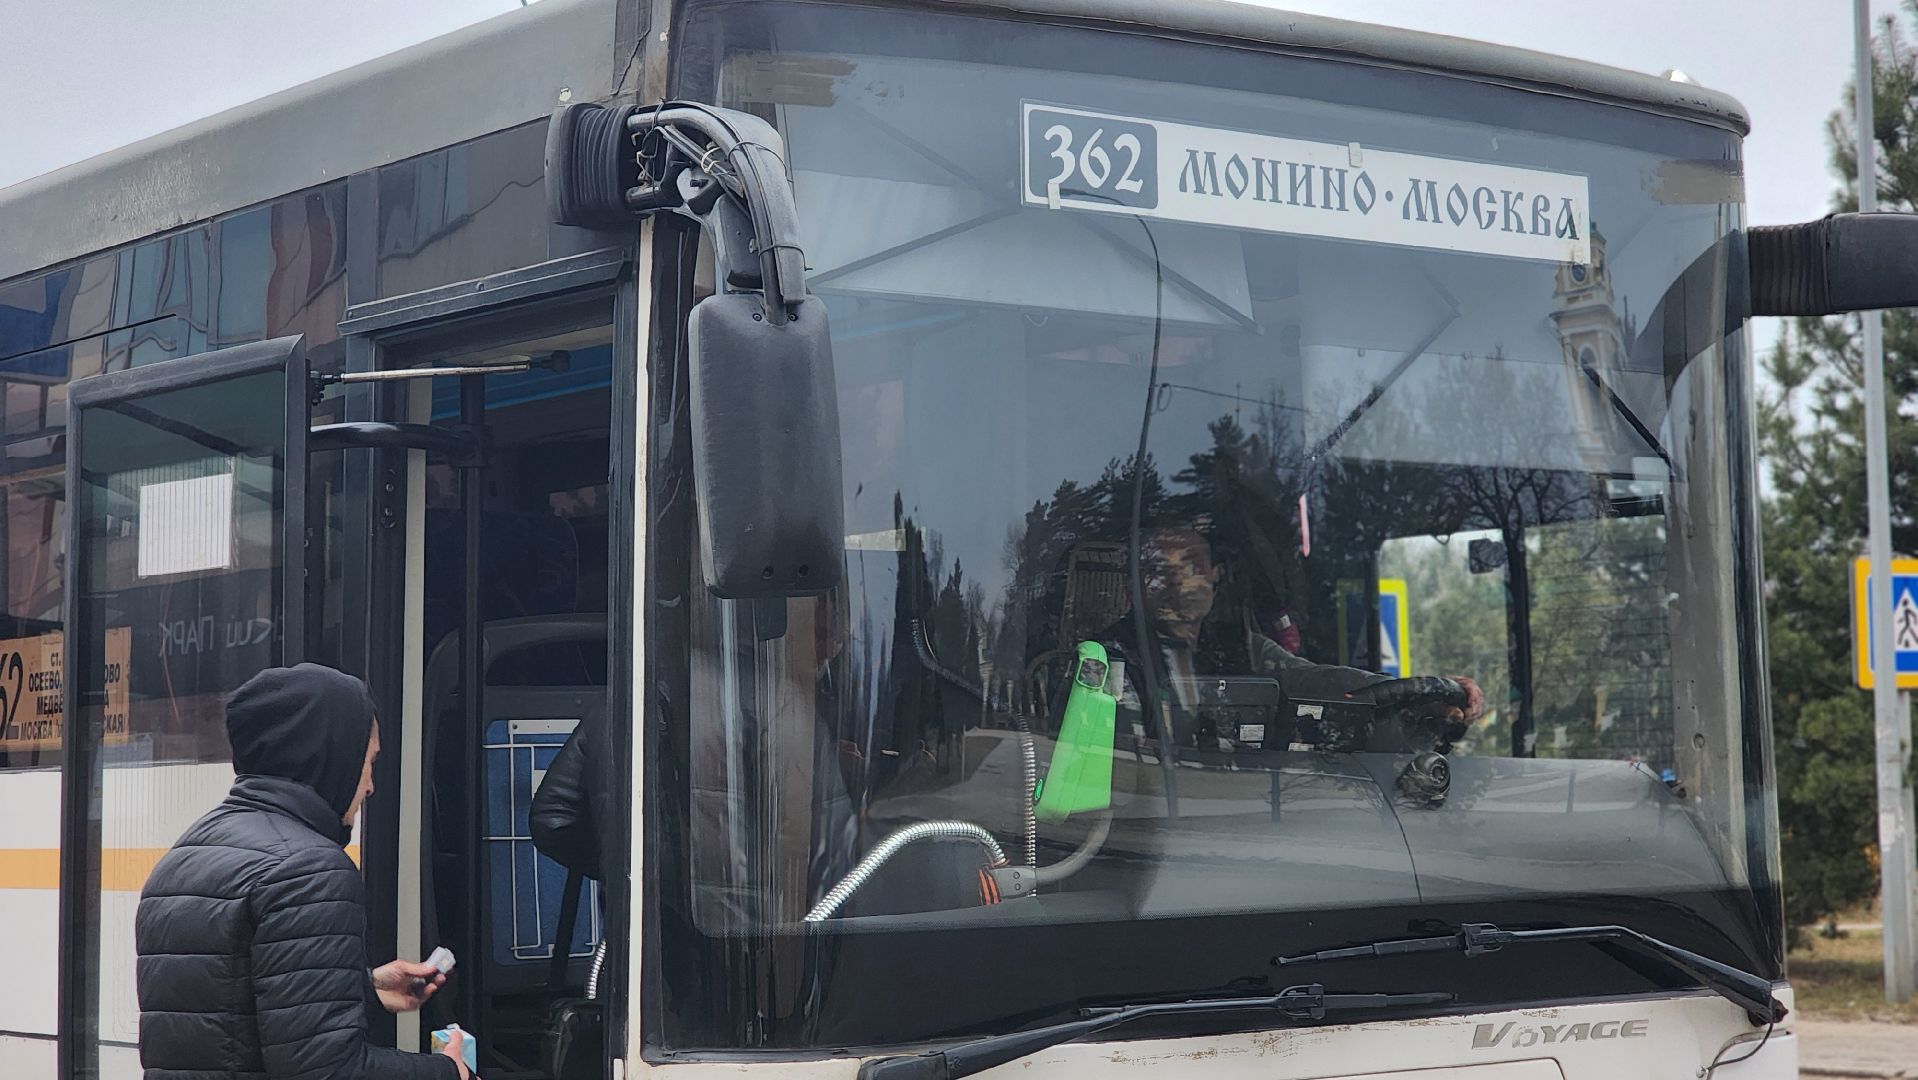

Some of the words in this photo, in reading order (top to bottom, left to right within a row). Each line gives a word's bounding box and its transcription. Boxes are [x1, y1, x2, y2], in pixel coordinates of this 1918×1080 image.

[1044, 124, 1144, 193] 362
[37, 694, 63, 717] МЕДВЕ
[21, 720, 53, 740] МОСКВА
[1472, 1019, 1650, 1050] VOYAGE
